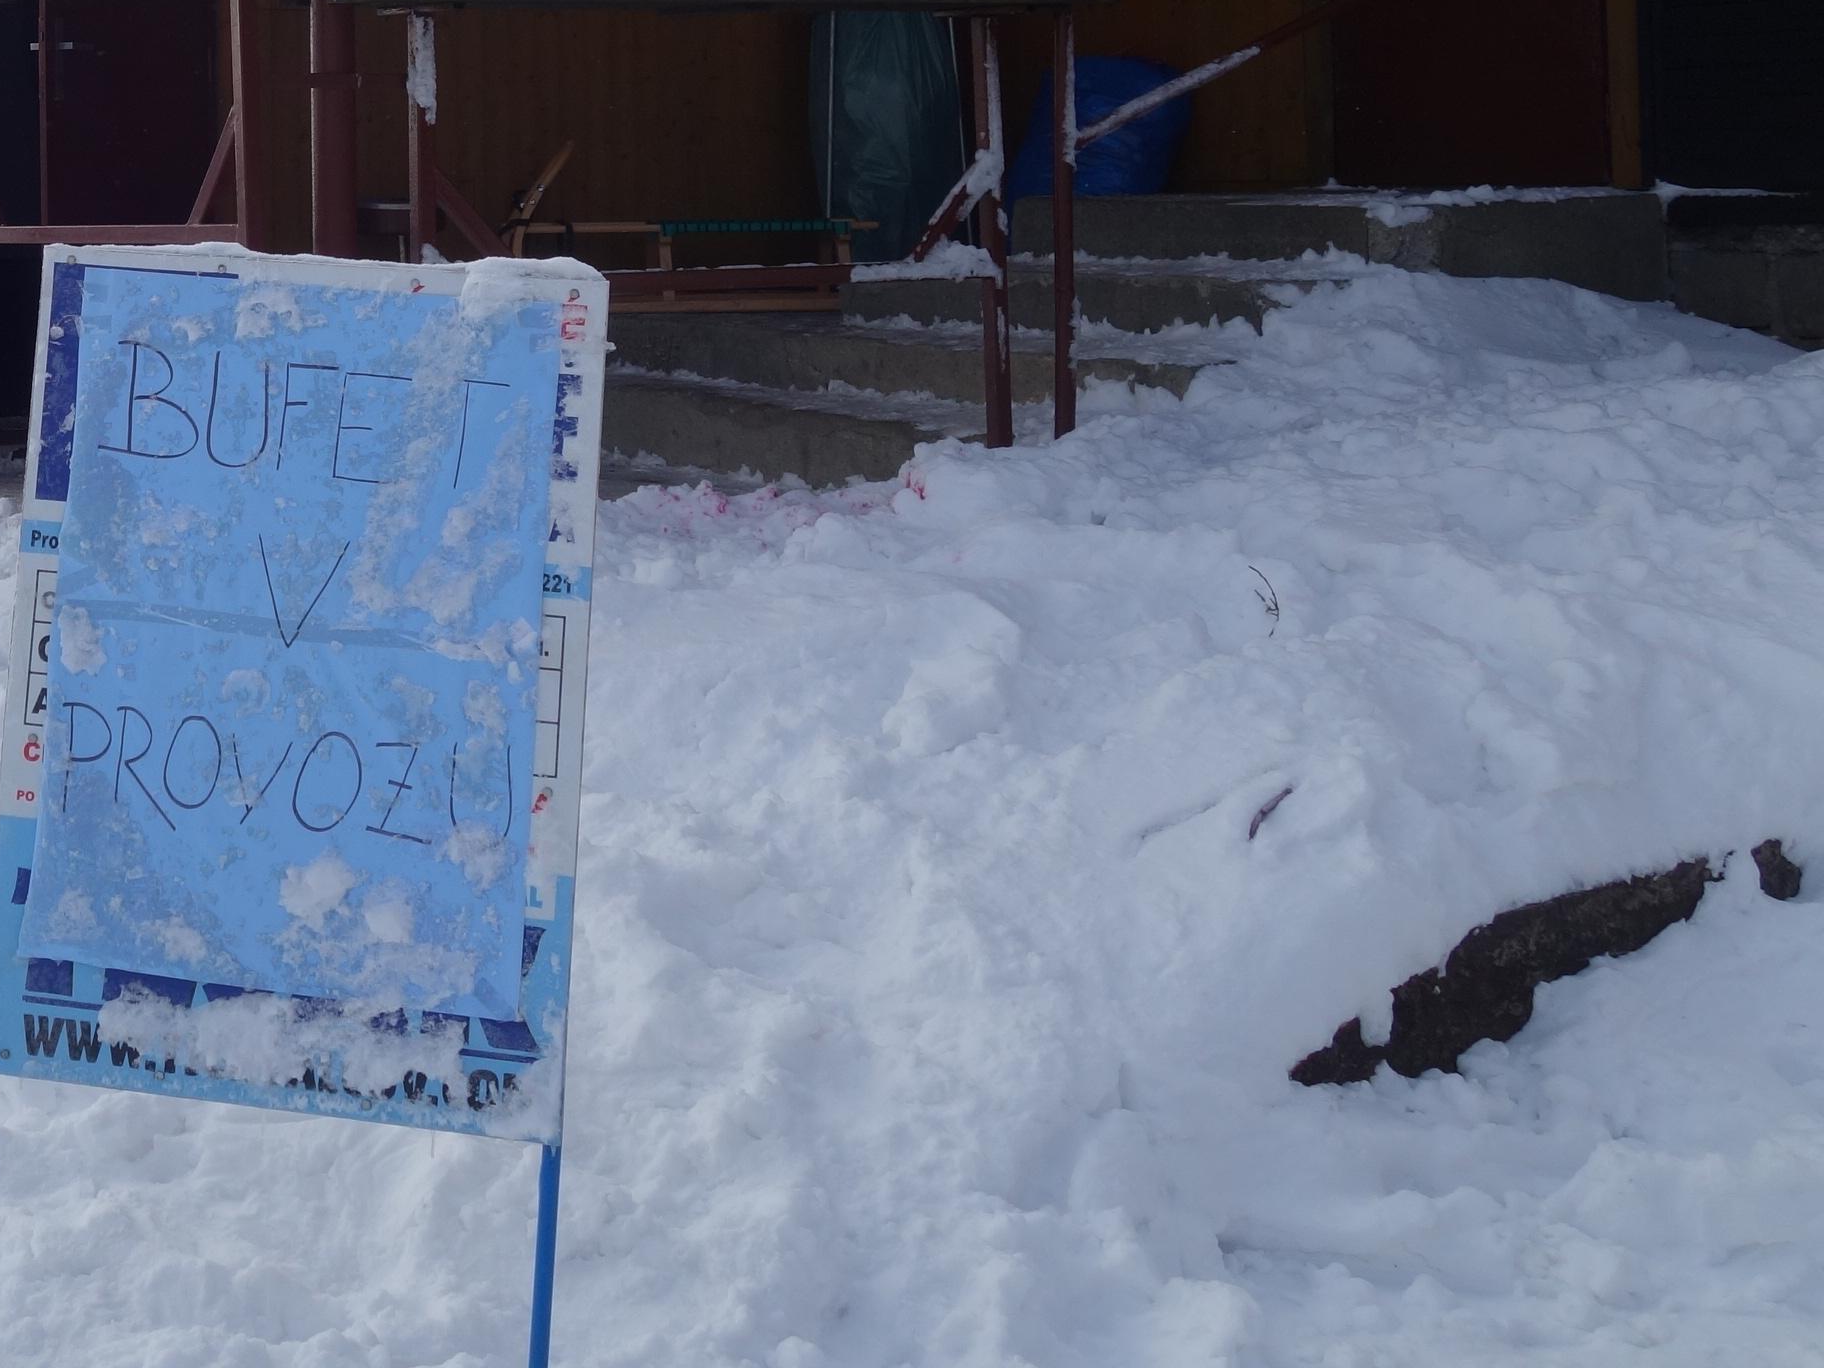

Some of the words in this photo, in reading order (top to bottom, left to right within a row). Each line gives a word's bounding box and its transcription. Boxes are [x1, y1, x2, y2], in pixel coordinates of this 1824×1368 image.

[97, 340, 510, 489] BUFET
[258, 533, 351, 649] V
[62, 701, 514, 845] PROVOZU
